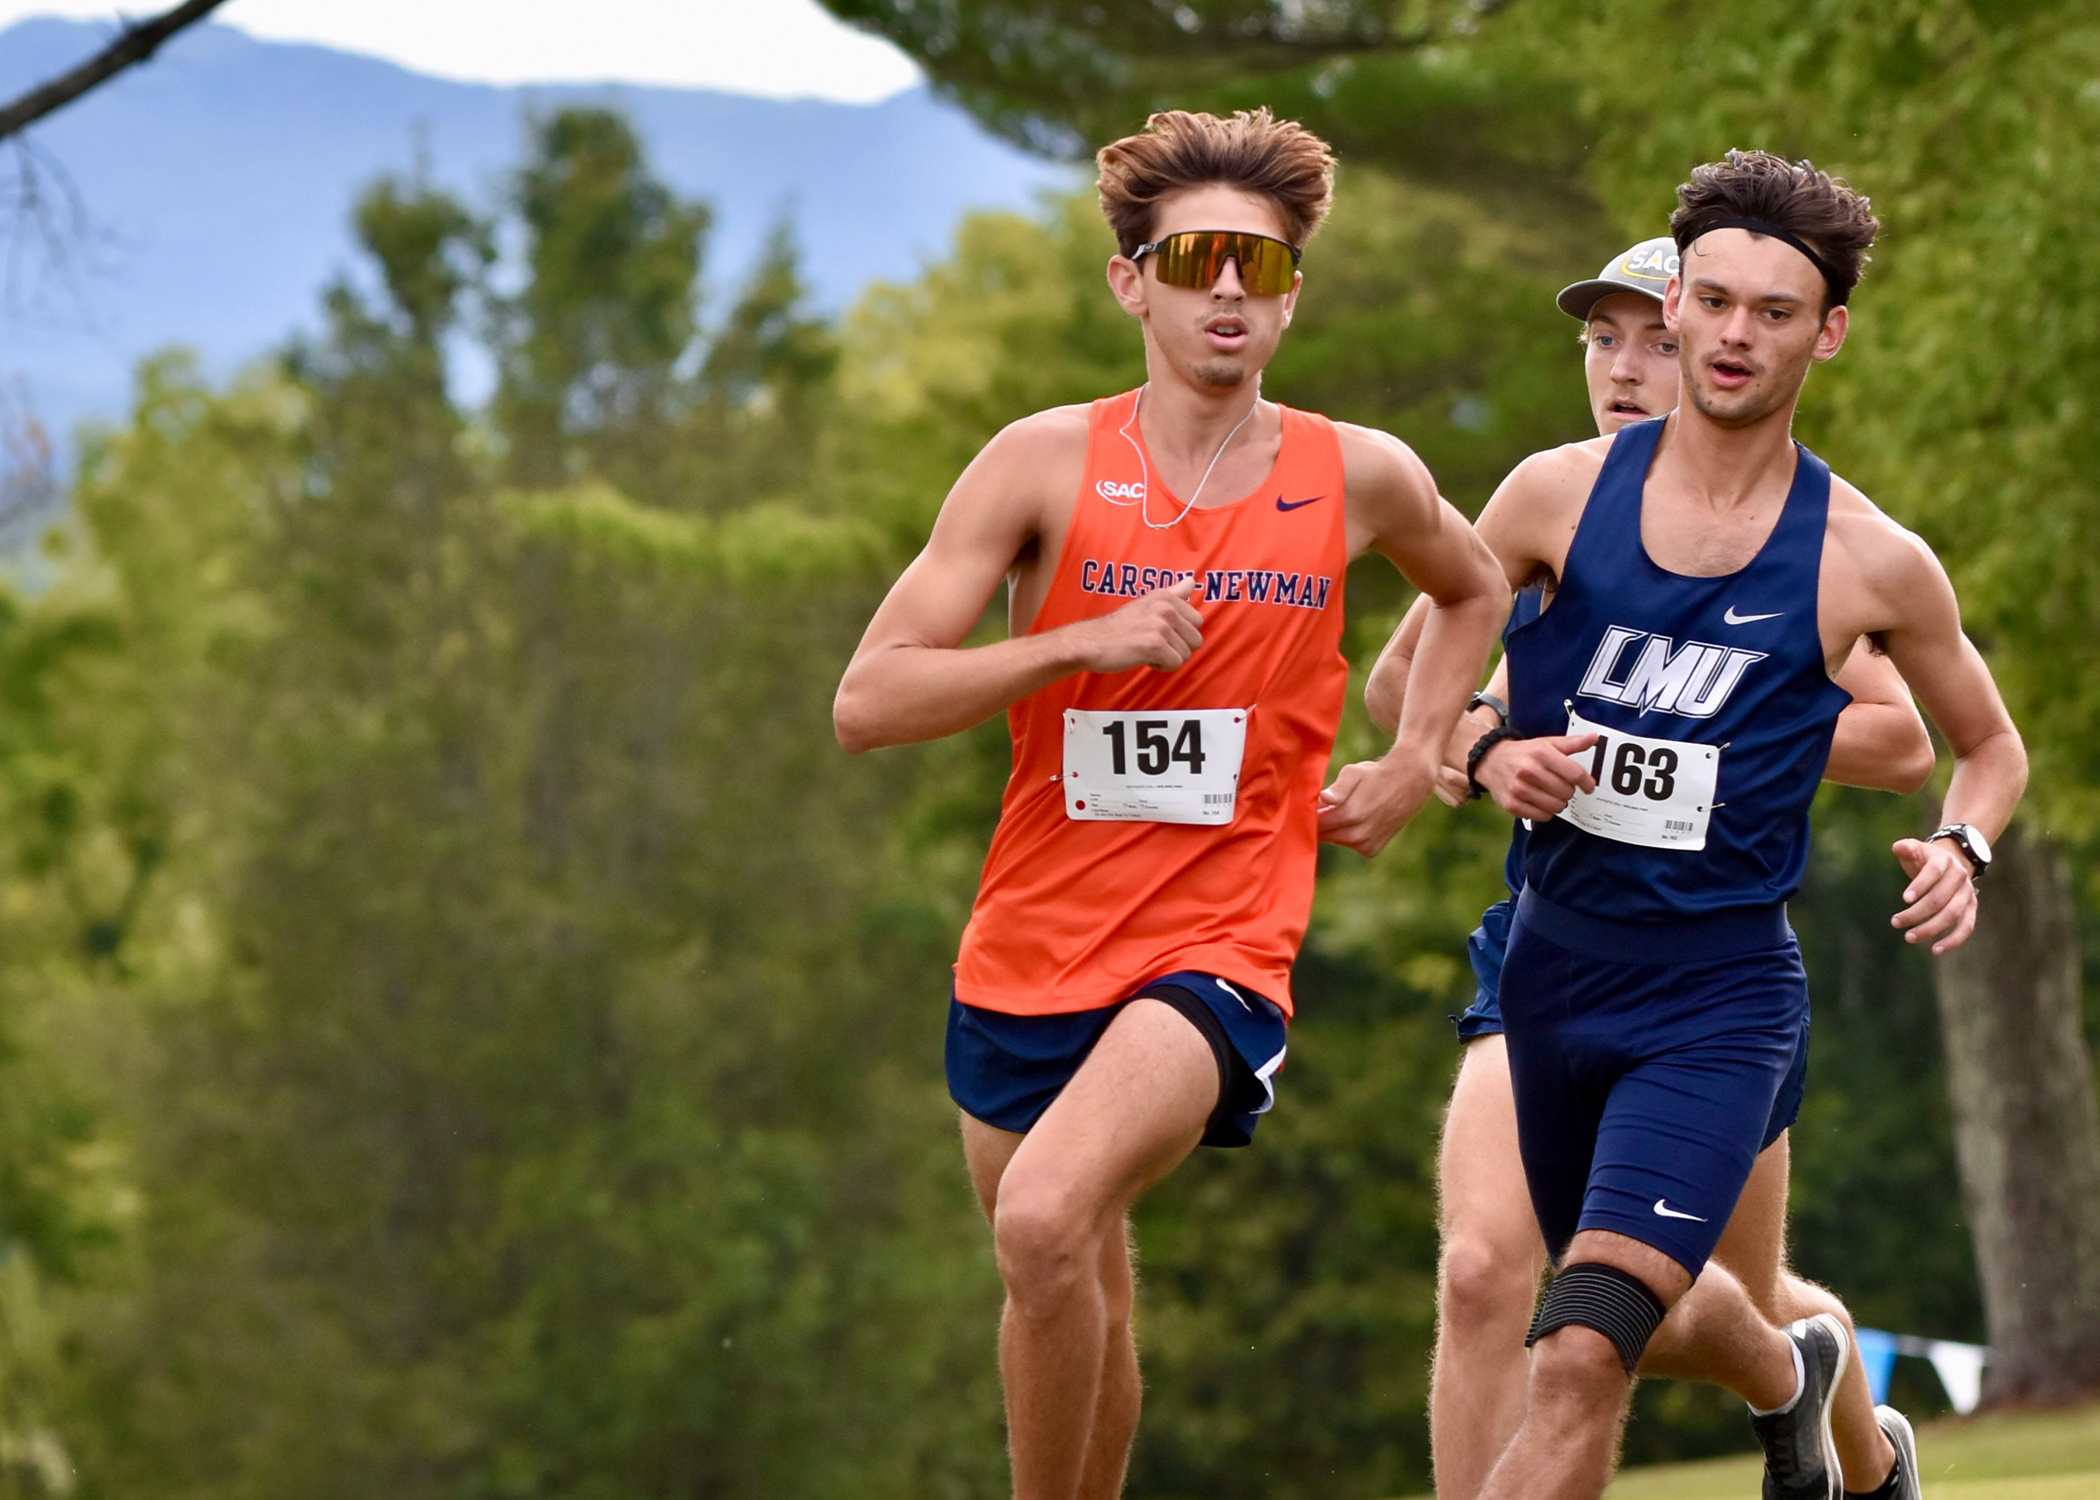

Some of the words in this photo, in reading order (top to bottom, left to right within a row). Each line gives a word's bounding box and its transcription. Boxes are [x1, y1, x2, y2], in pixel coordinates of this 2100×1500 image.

[1627, 249, 1680, 275] SAC
[1102, 480, 1145, 499] SAC
[1080, 558, 1332, 610] CARSO-NEWMAN
[1576, 624, 1771, 719] LMU
[1102, 719, 1206, 776] 154
[1590, 734, 1679, 802] 163
